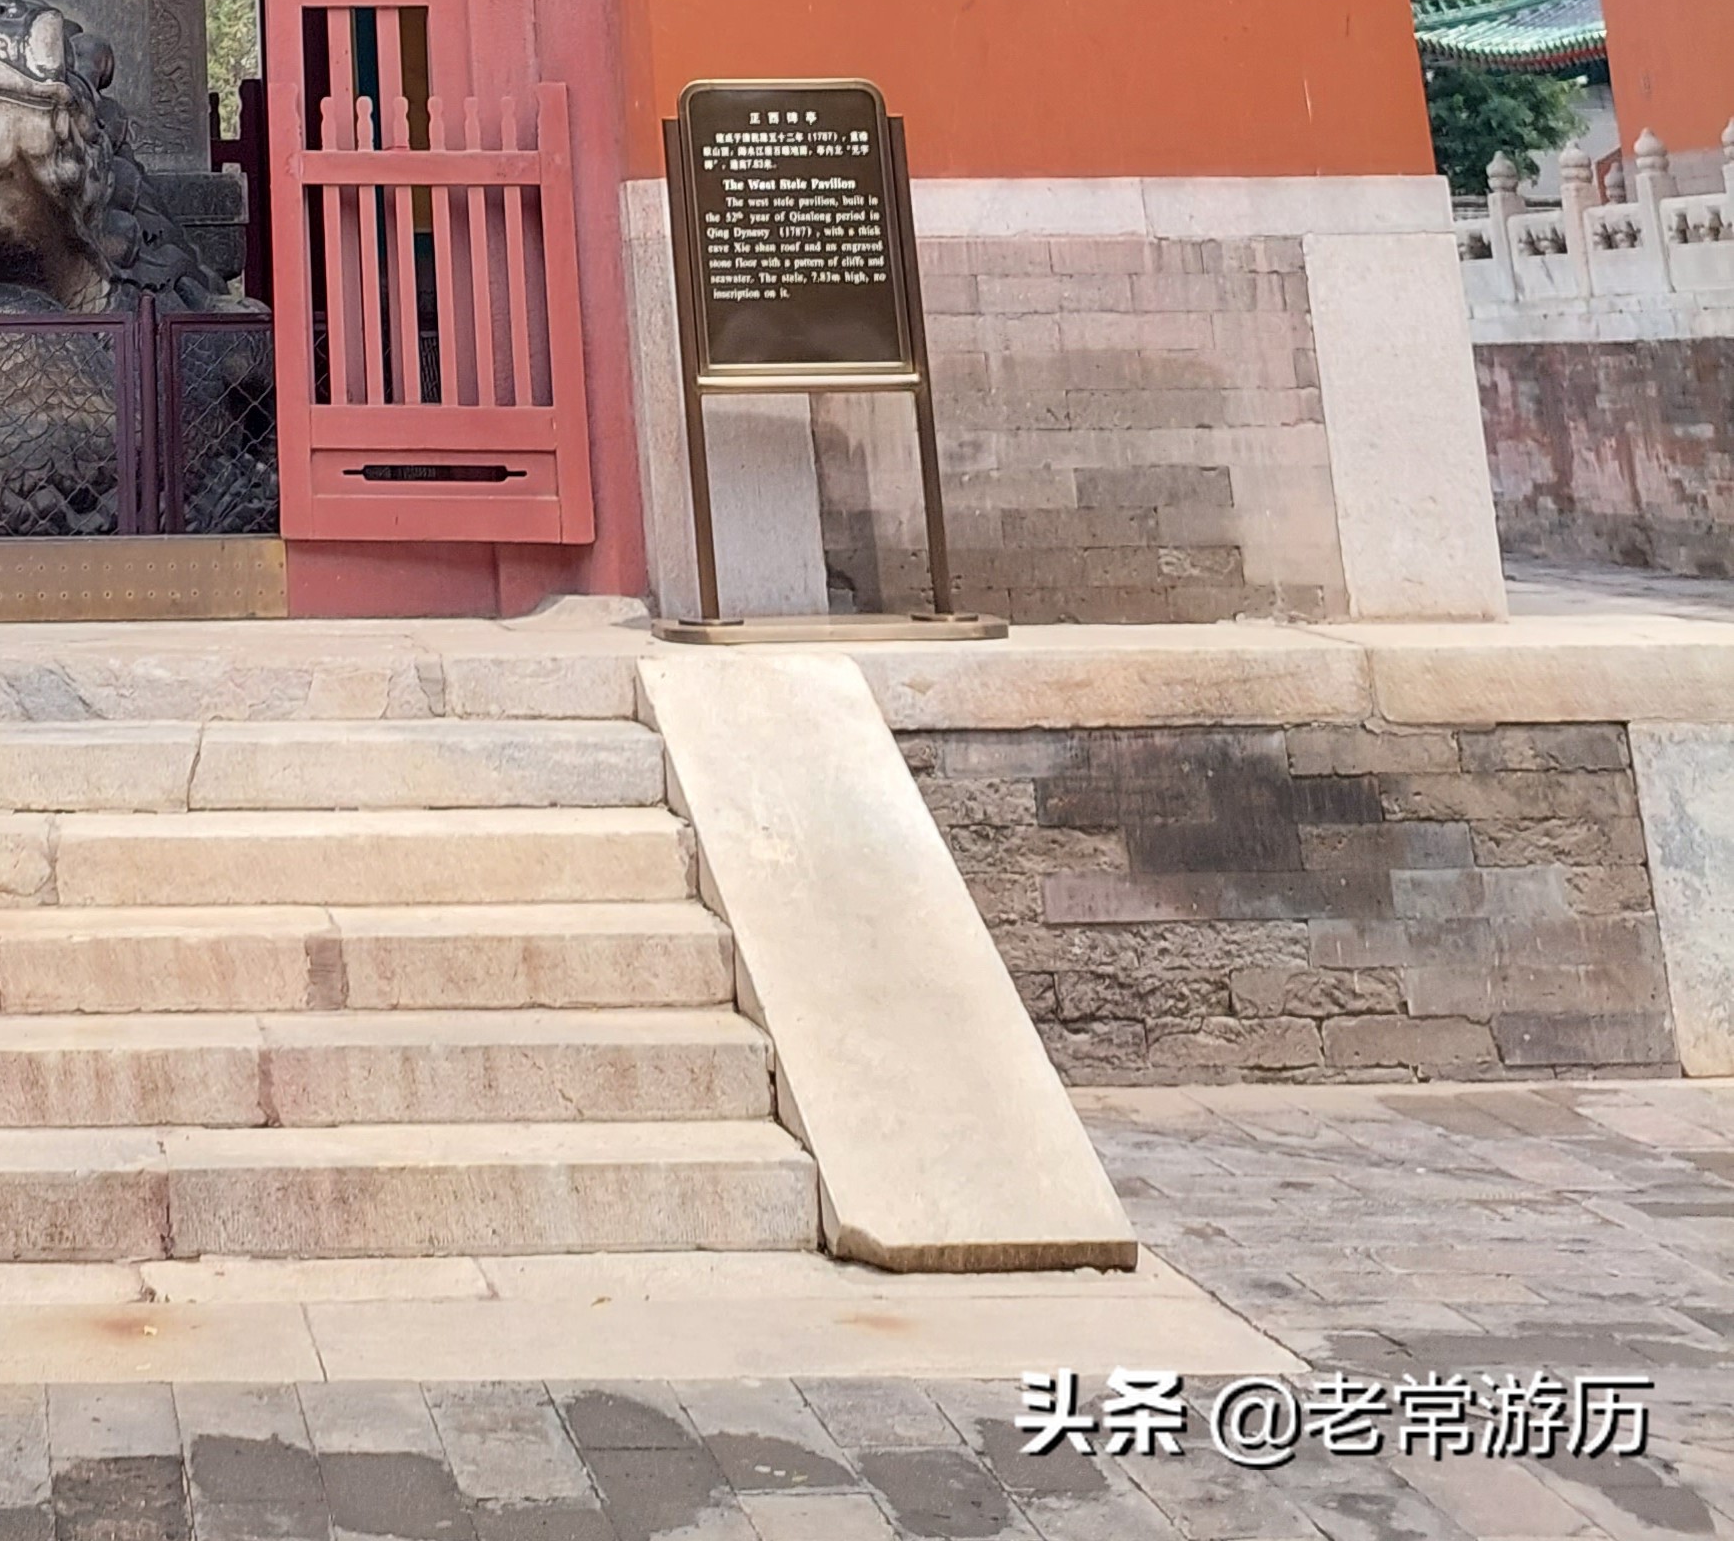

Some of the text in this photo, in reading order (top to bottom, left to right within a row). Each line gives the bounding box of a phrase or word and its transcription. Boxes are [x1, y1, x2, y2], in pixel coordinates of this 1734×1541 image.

[723, 179, 744, 190] The
[748, 179, 775, 190] West
[811, 178, 855, 189] Pavilion
[726, 197, 743, 207] The
[748, 199, 769, 207] west
[799, 196, 838, 209] pavilion,
[842, 195, 864, 205] built
[869, 195, 878, 205] in
[706, 212, 720, 223] the
[750, 213, 770, 224] year
[775, 212, 785, 221] of
[789, 211, 831, 223] Qianlong
[836, 210, 865, 223] period
[870, 210, 879, 220] in
[707, 228, 729, 240] Qing
[734, 227, 770, 239] Dynasty
[824, 226, 844, 236] with
[848, 228, 854, 236] a
[858, 225, 881, 236] thick
[734, 242, 750, 253] Xie
[755, 243, 776, 253] shan
[780, 242, 800, 252] roof
[805, 242, 821, 252] and
[826, 243, 837, 252] an
[841, 240, 883, 253] engraved
[735, 257, 757, 268] floor
[761, 257, 780, 267] with
[828, 256, 838, 267] of
[868, 256, 884, 266] and
[759, 273, 777, 283] The
[845, 271, 869, 284] high,
[713, 287, 760, 301] inscription
[764, 289, 776, 298] on
